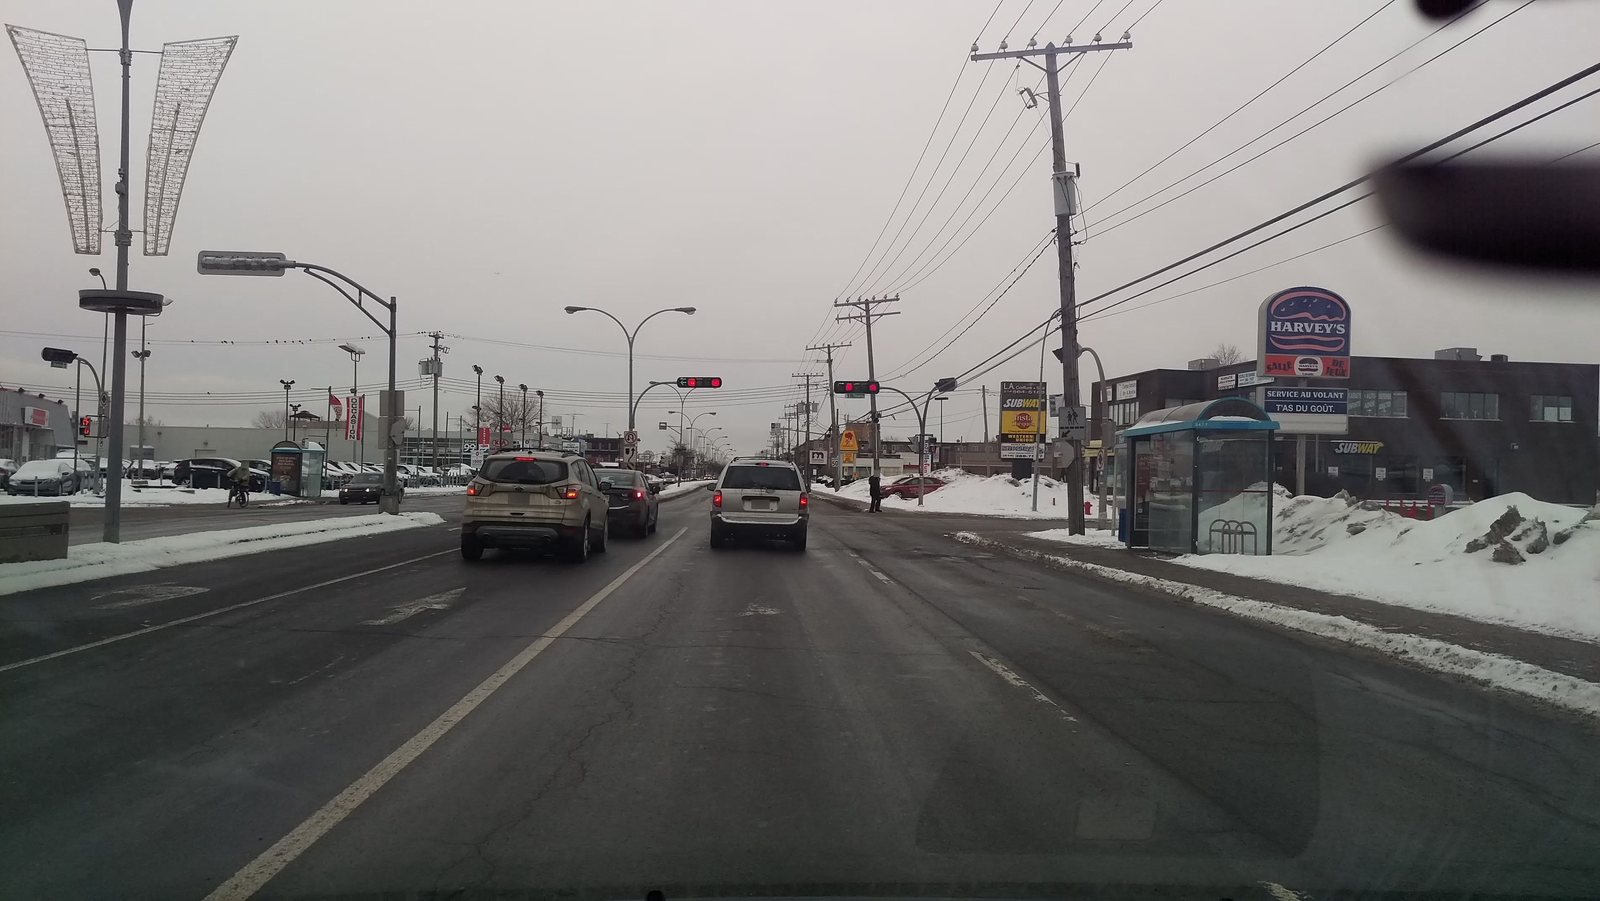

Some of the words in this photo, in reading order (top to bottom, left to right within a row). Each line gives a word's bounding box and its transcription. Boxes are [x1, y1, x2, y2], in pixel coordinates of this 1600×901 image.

[1270, 321, 1346, 334] HARVEY'S
[1266, 361, 1293, 372] SALLE
[1332, 359, 1345, 367] DE
[1325, 367, 1347, 377] JEUX
[1266, 390, 1299, 398] SERVICE
[1313, 391, 1344, 399] VOLANT
[1275, 404, 1294, 412] T'AS
[1295, 404, 1308, 412] DU
[349, 397, 358, 440] OCCASION
[1334, 441, 1383, 454] SUBWAY
